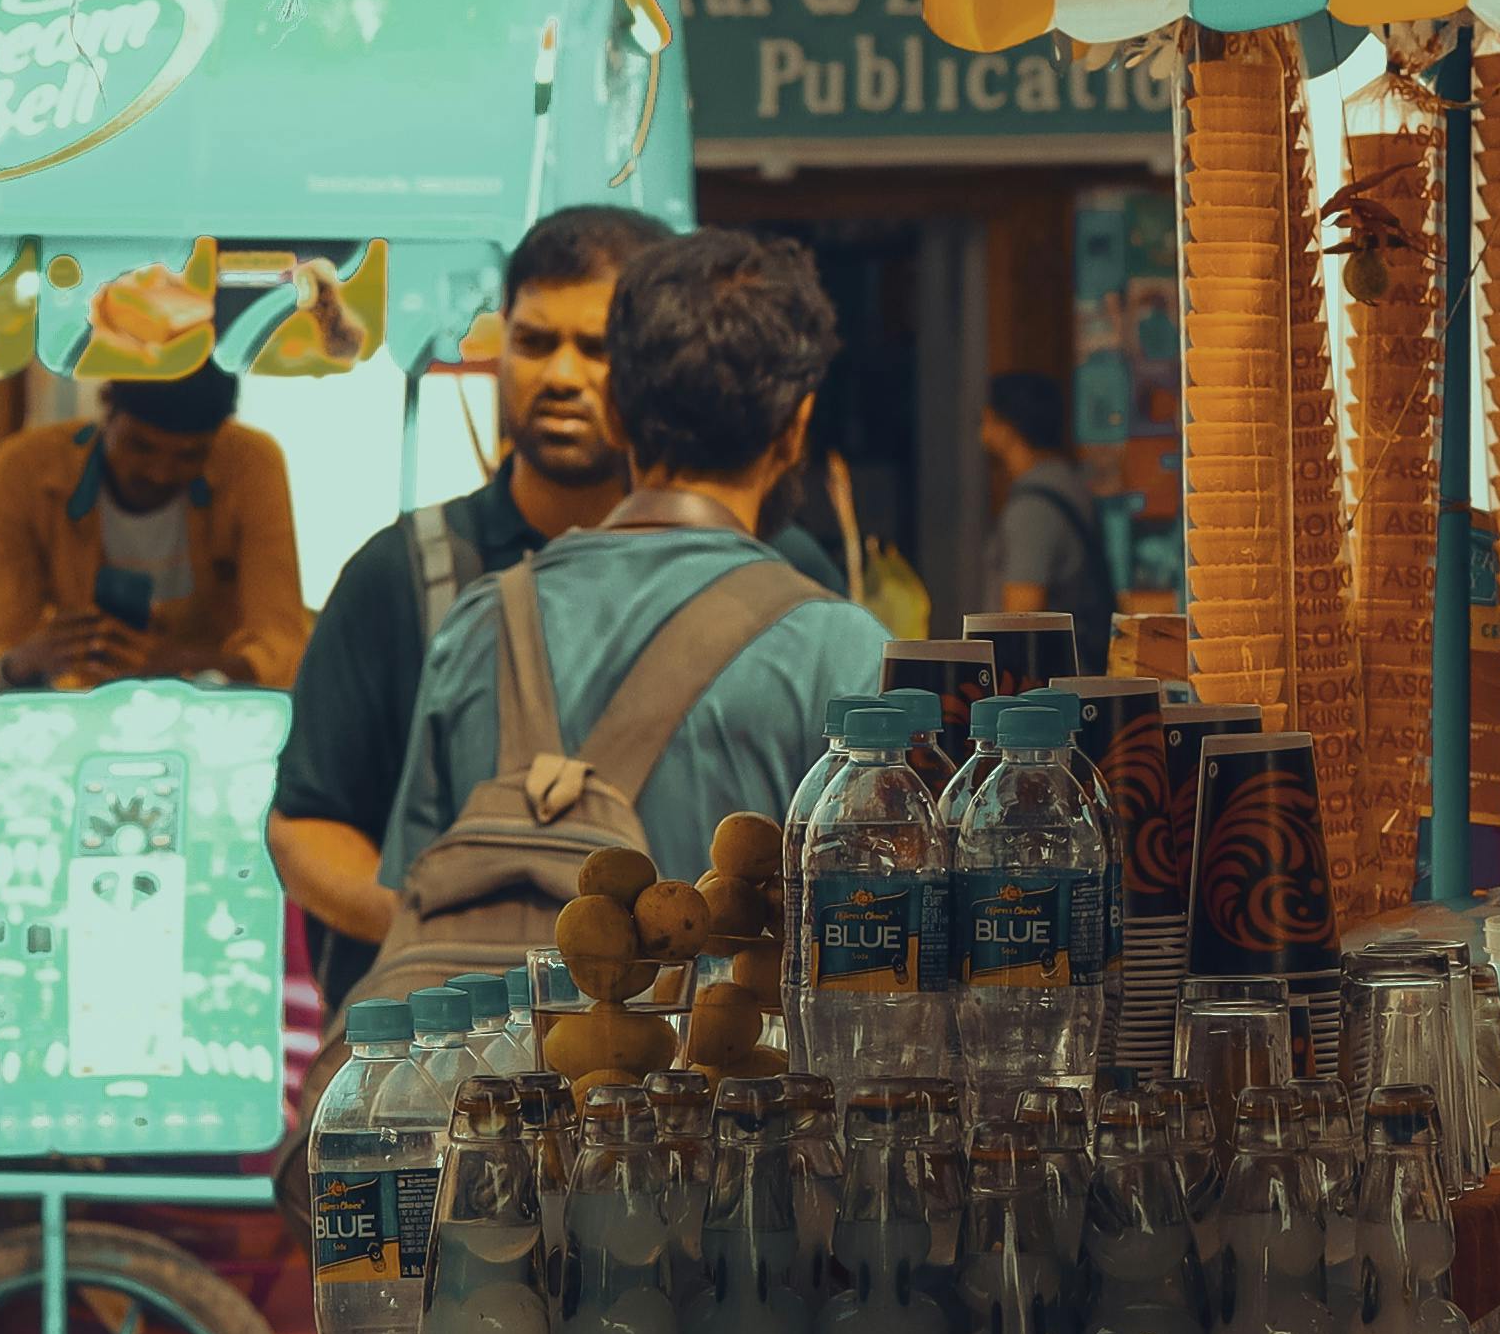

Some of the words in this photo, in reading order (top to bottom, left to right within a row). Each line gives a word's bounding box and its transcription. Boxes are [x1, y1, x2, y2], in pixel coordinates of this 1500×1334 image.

[824, 923, 902, 949] BLUE
[975, 918, 1051, 944] BLUE
[315, 1214, 377, 1240] BLUE
